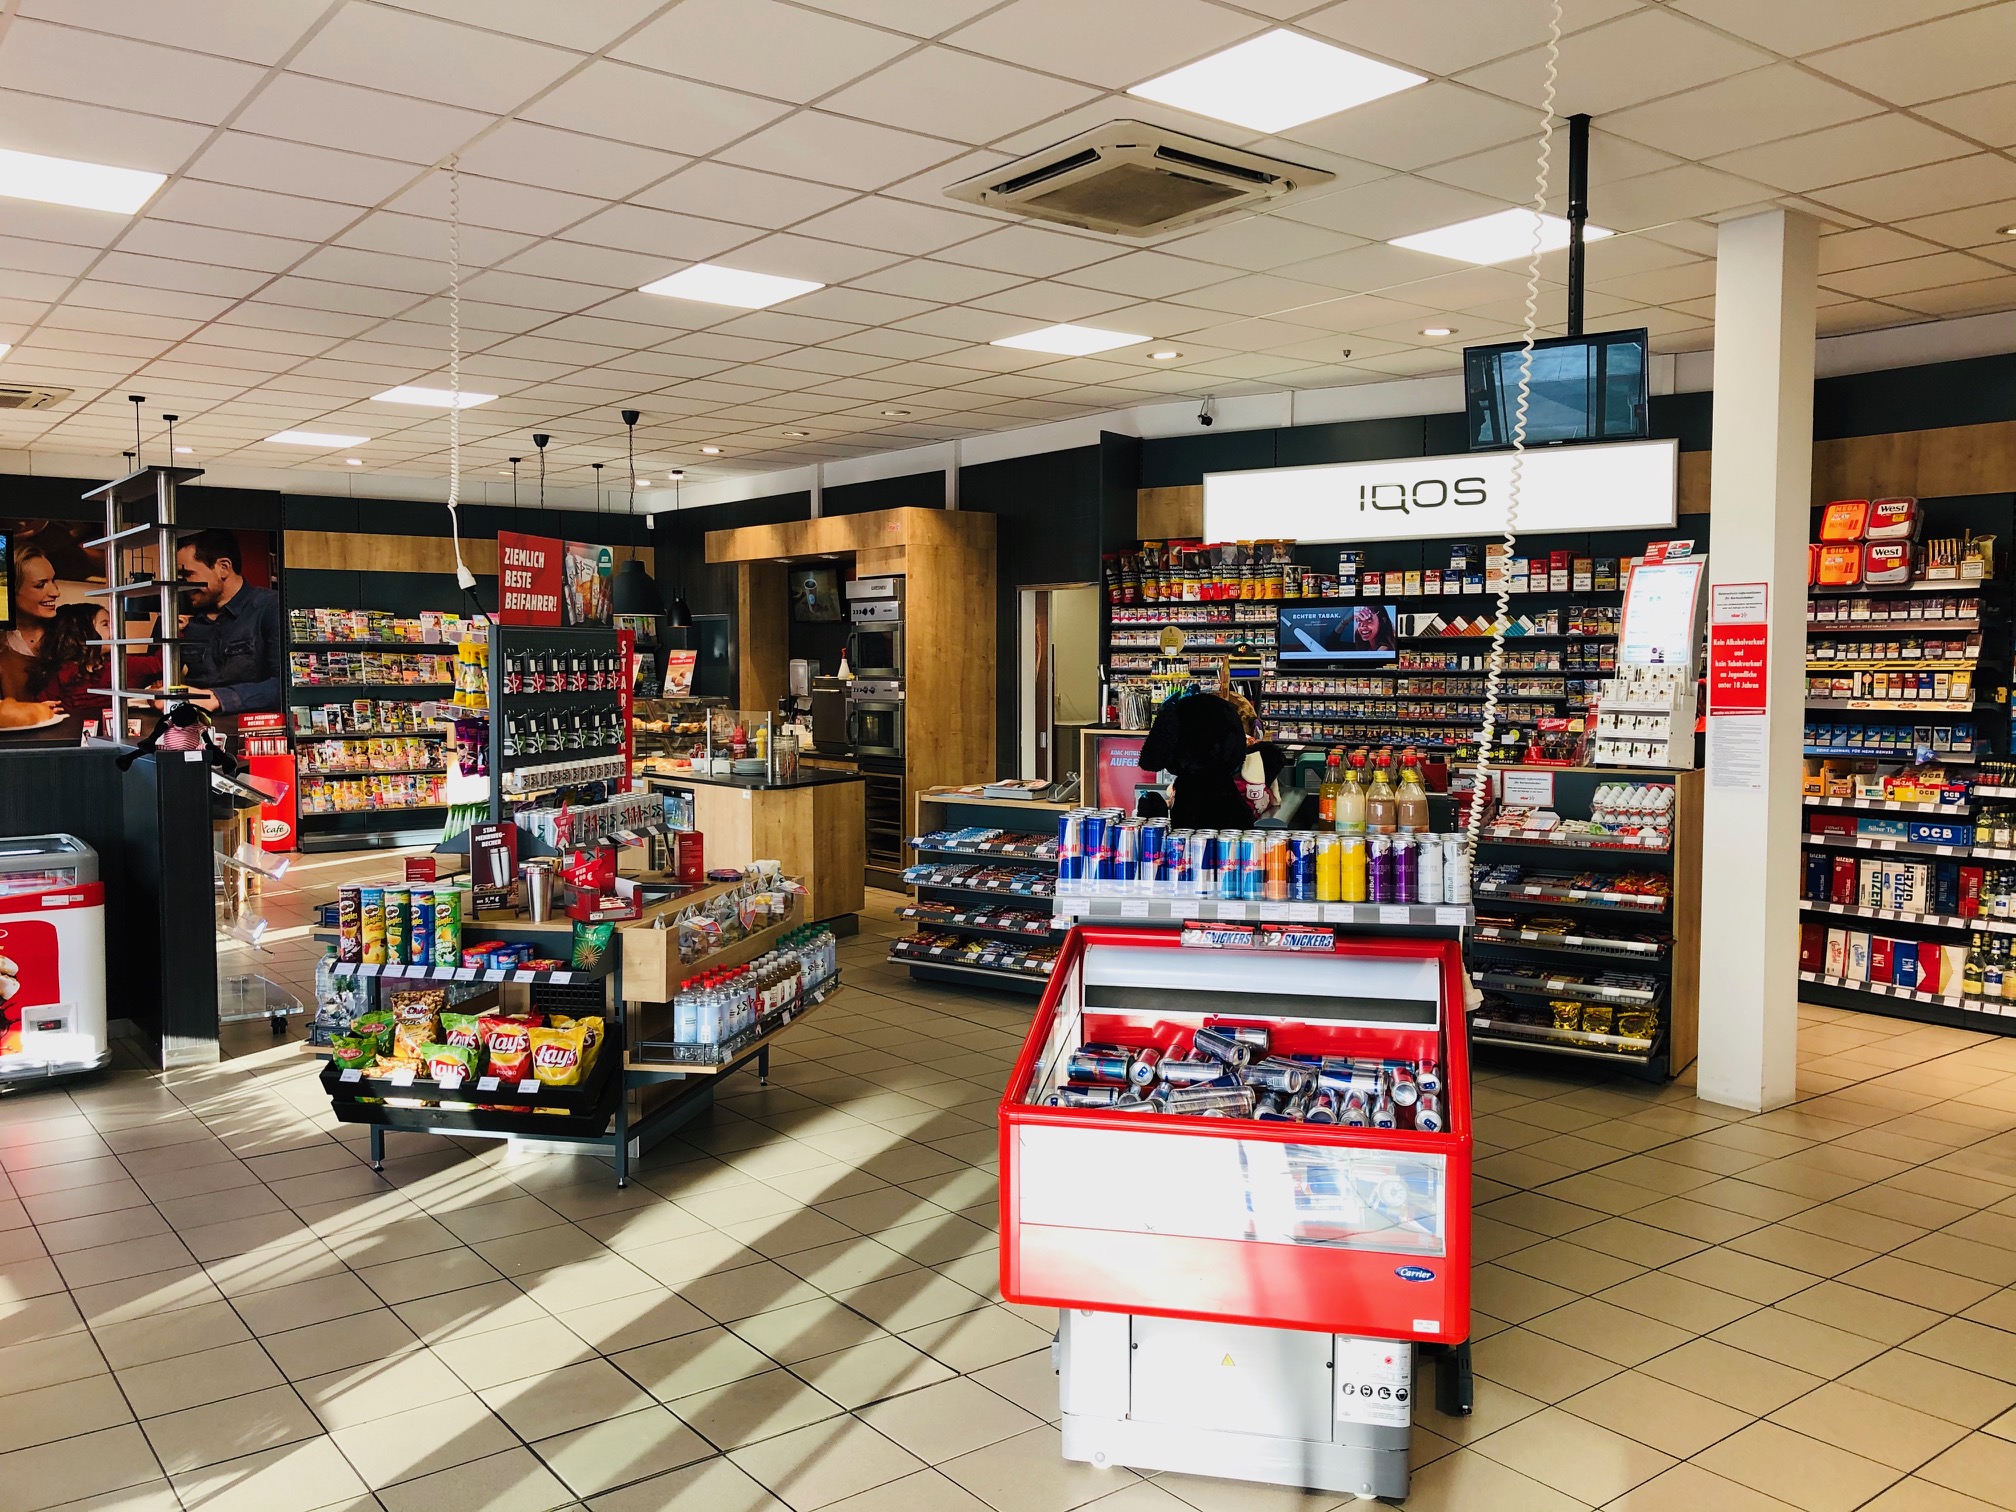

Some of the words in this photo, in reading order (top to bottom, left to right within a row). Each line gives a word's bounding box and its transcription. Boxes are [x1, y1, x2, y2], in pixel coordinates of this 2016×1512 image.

[1360, 477, 1486, 515] IQOS
[1880, 504, 1905, 512] West
[504, 547, 545, 568] ZIEMLICH
[1874, 547, 1899, 556] West
[504, 569, 532, 589] BESTE
[504, 592, 558, 612] BEIFAHRER!
[1713, 638, 1725, 646] Kein
[1726, 638, 1766, 646] Alkoholverkauf
[1728, 670, 1758, 680] Jugendliche
[1541, 718, 1567, 730] Smoking
[1920, 772, 1942, 780] OCB
[482, 826, 497, 834] STAR
[1919, 826, 1952, 839] OCB
[481, 838, 502, 848] BECHER
[576, 868, 586, 876] NUR
[1870, 871, 1882, 908] GIZEH
[1904, 864, 1914, 902] GIZEH
[1894, 873, 1904, 910] GIZEH
[1190, 930, 1202, 942] 2
[1202, 932, 1252, 945] SNICKERS
[1268, 932, 1281, 946] 2
[1282, 934, 1334, 947] SNICKERS
[489, 1033, 528, 1054] Lay's
[537, 1045, 575, 1068] Lay's
[1400, 1268, 1432, 1279] Carrier
